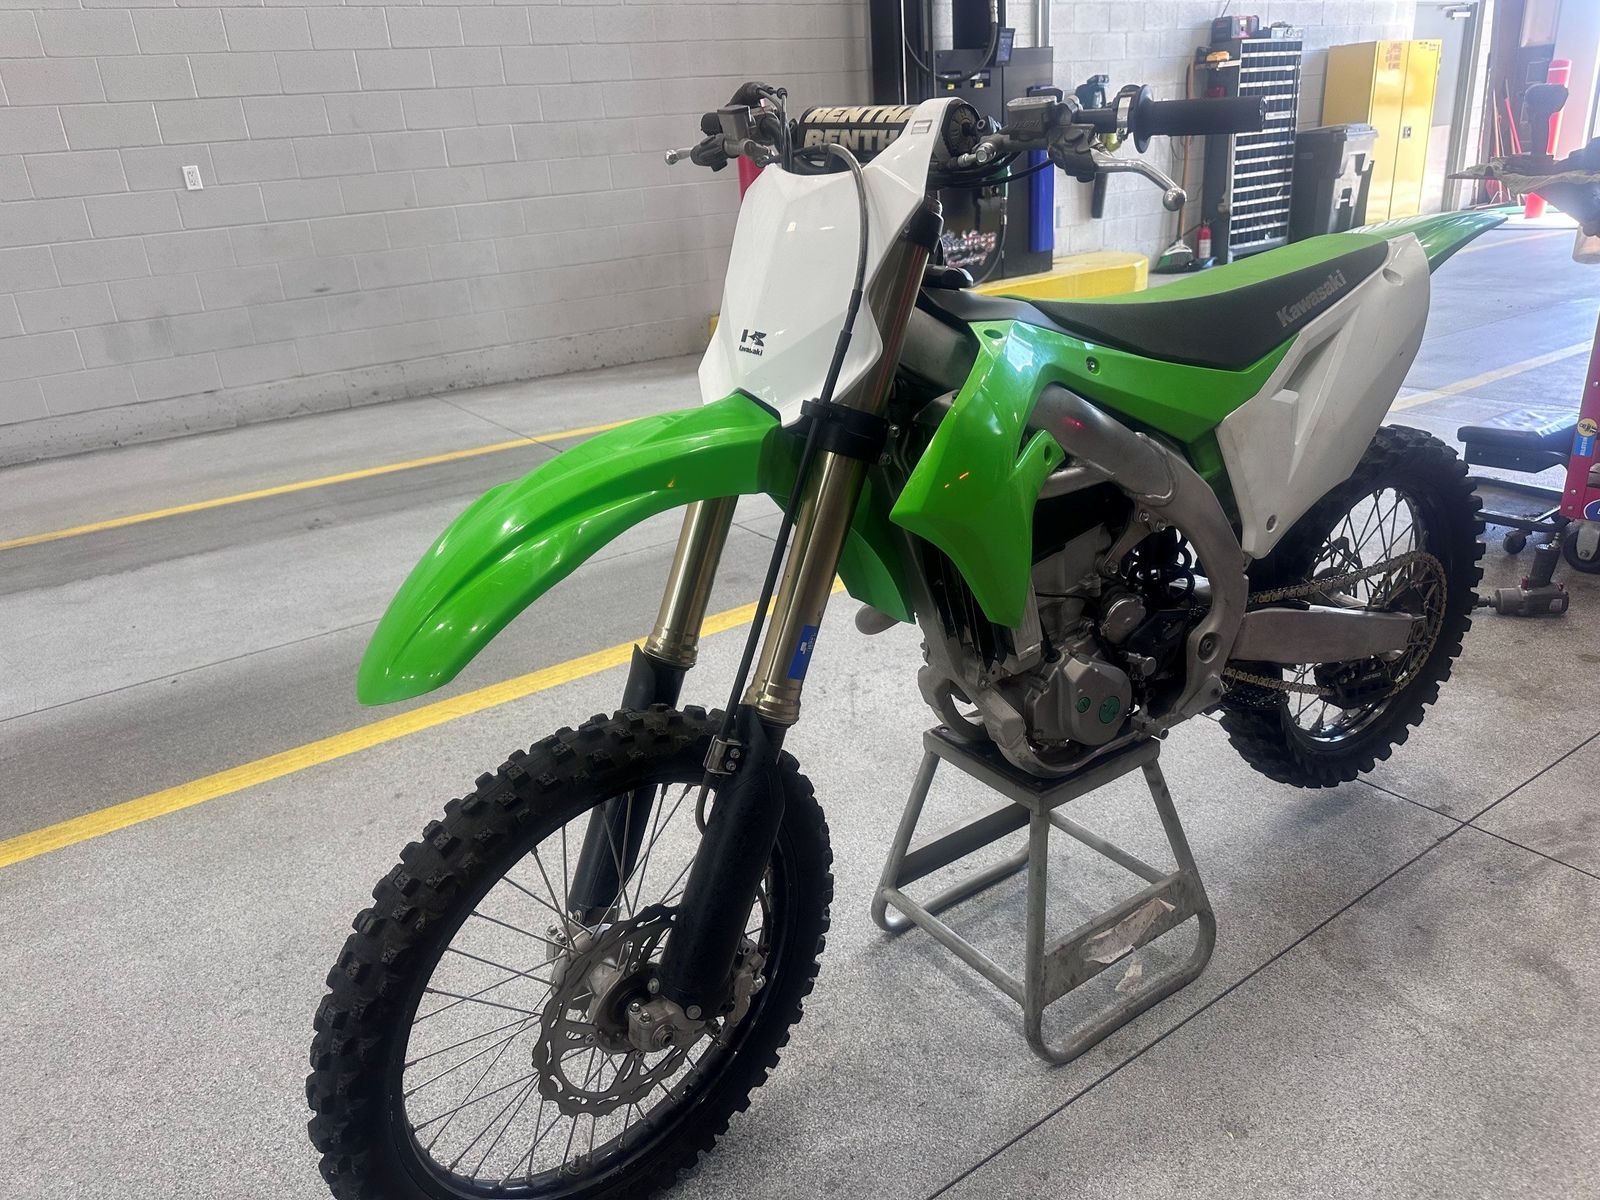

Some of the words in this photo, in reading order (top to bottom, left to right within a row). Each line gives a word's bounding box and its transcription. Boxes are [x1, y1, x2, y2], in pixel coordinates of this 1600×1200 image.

[804, 106, 914, 123] RENTHA
[804, 129, 899, 151] RENTH
[1276, 269, 1347, 327] Kawasaki
